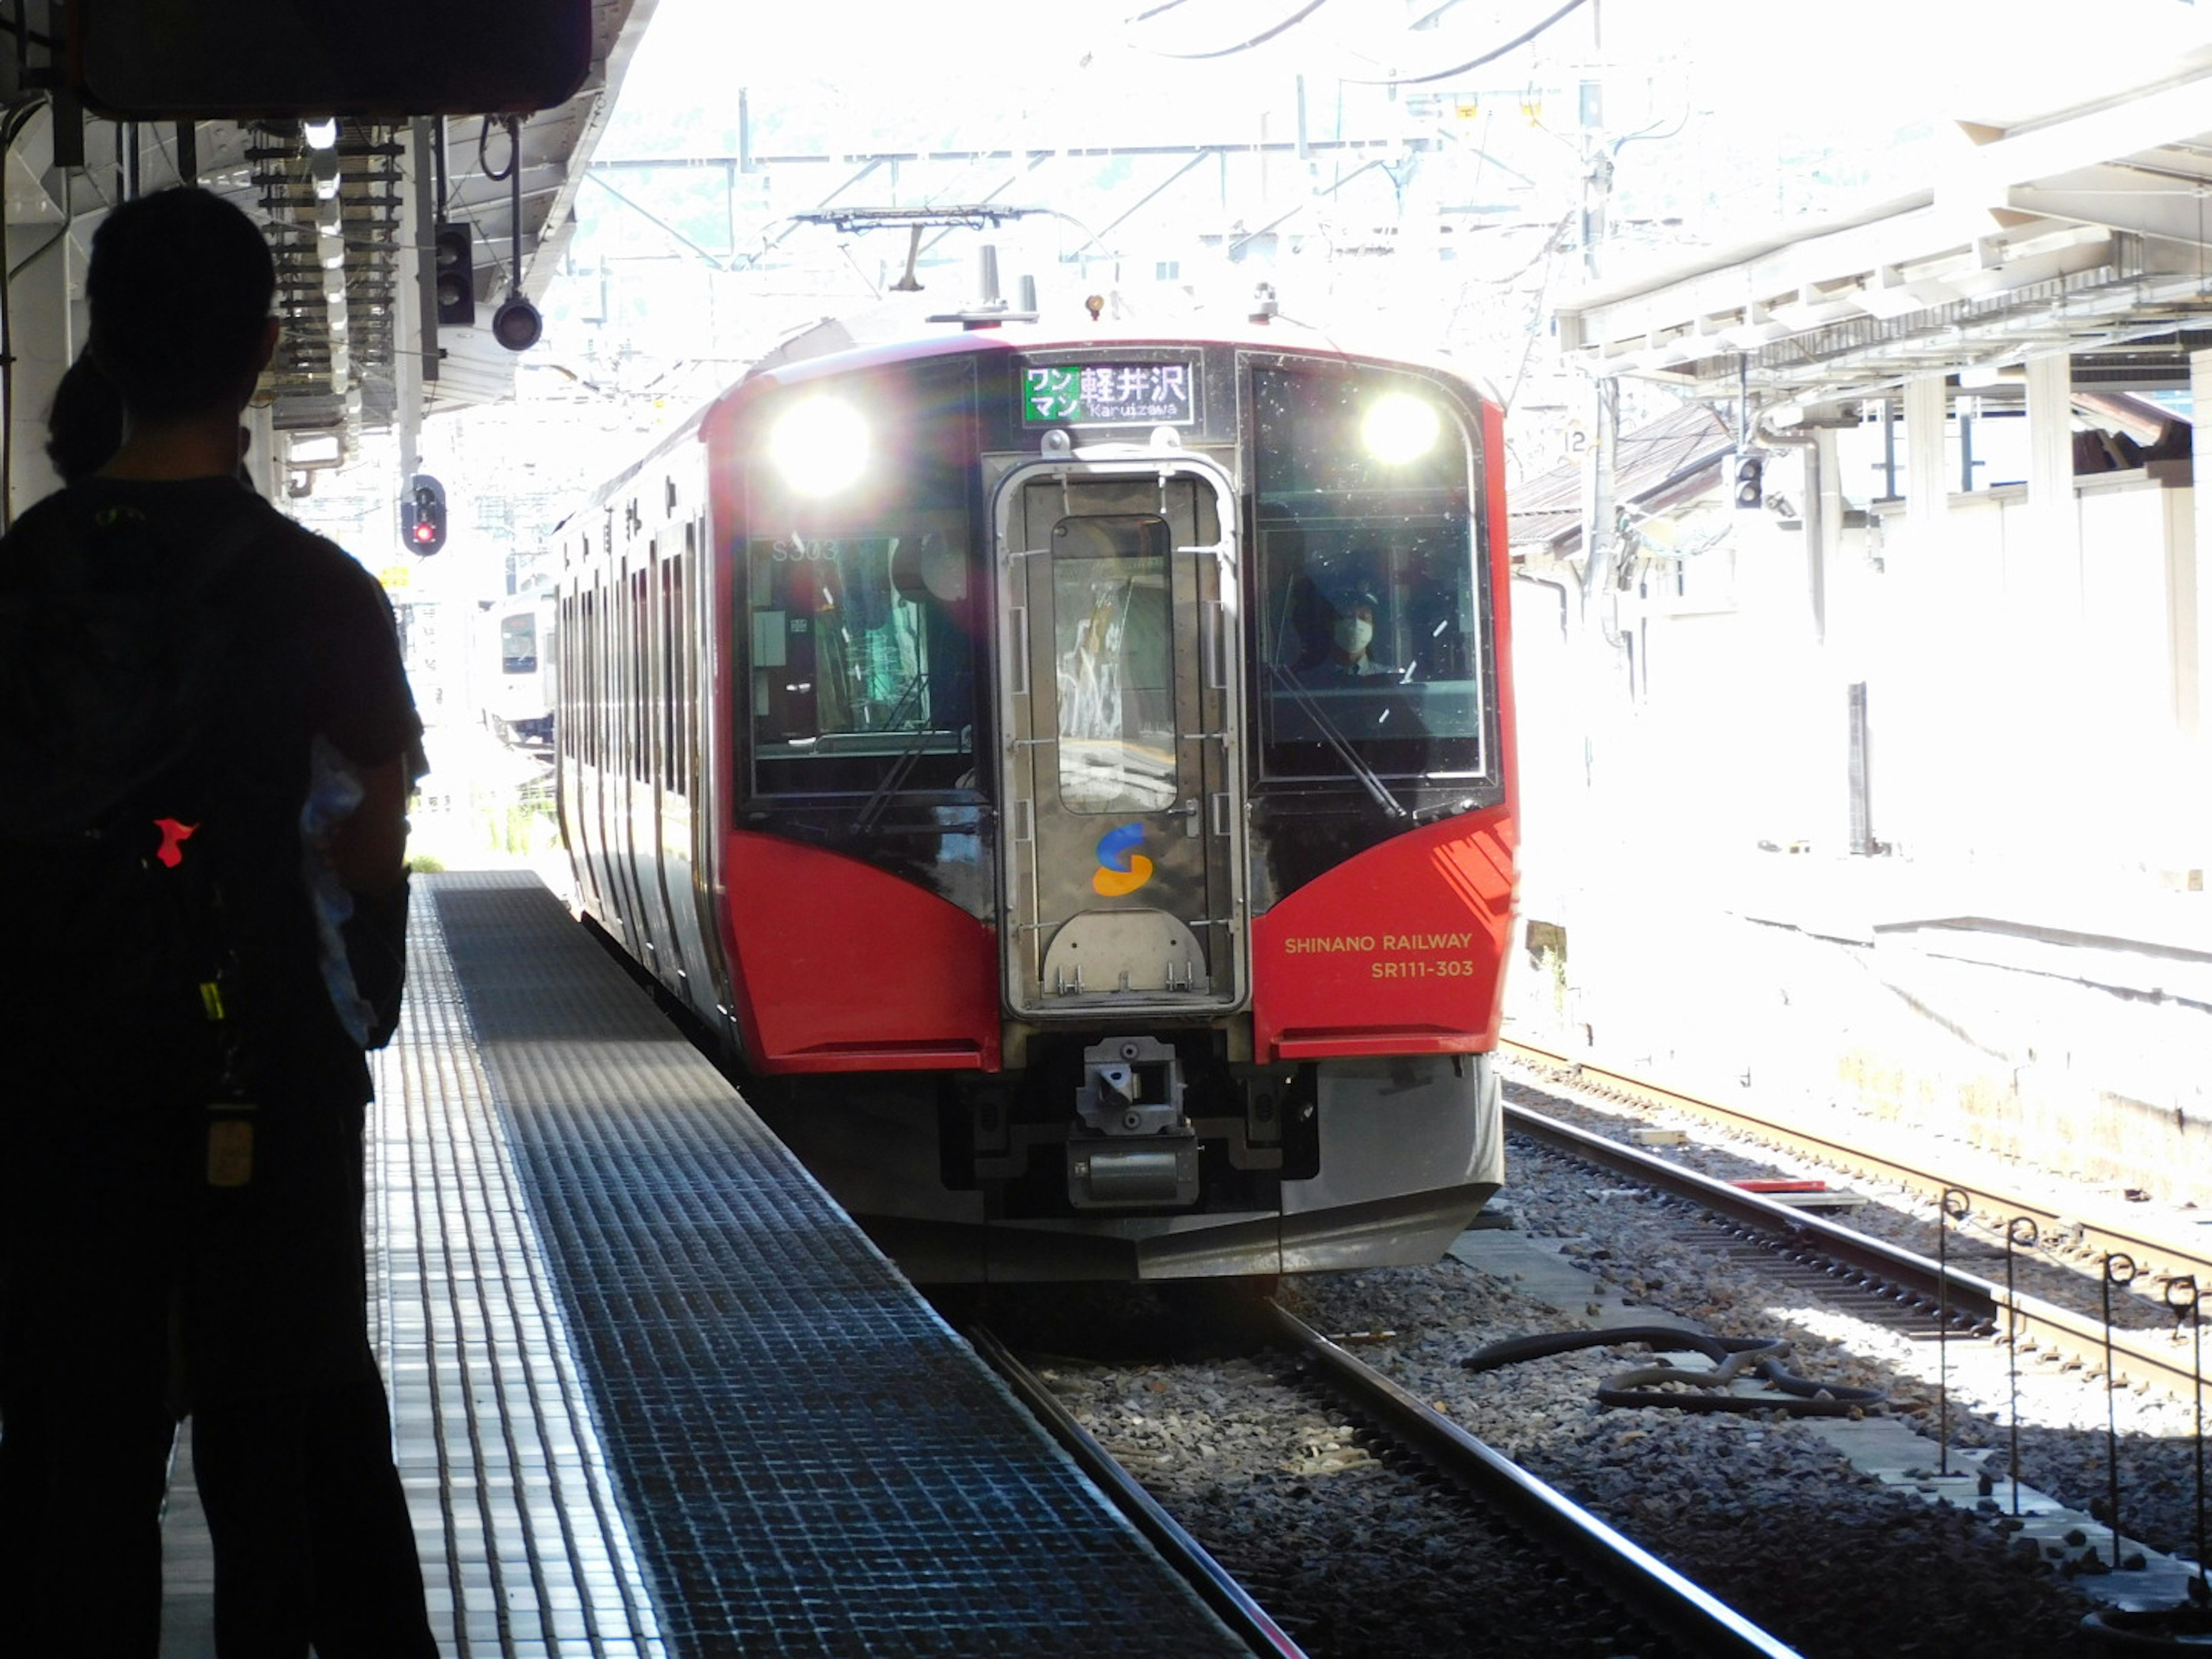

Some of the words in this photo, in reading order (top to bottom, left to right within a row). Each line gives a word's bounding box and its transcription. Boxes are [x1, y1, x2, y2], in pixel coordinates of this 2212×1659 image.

[1028, 369, 1073, 391] ワン
[1080, 366, 1187, 403] 軽井沢
[1031, 396, 1078, 416] マン
[1090, 403, 1177, 418] Karuizawa
[772, 540, 839, 562] S303
[1285, 935, 1376, 954] SHINANO
[1382, 933, 1472, 950] RAILWAY
[1371, 960, 1474, 978] SR111-303
